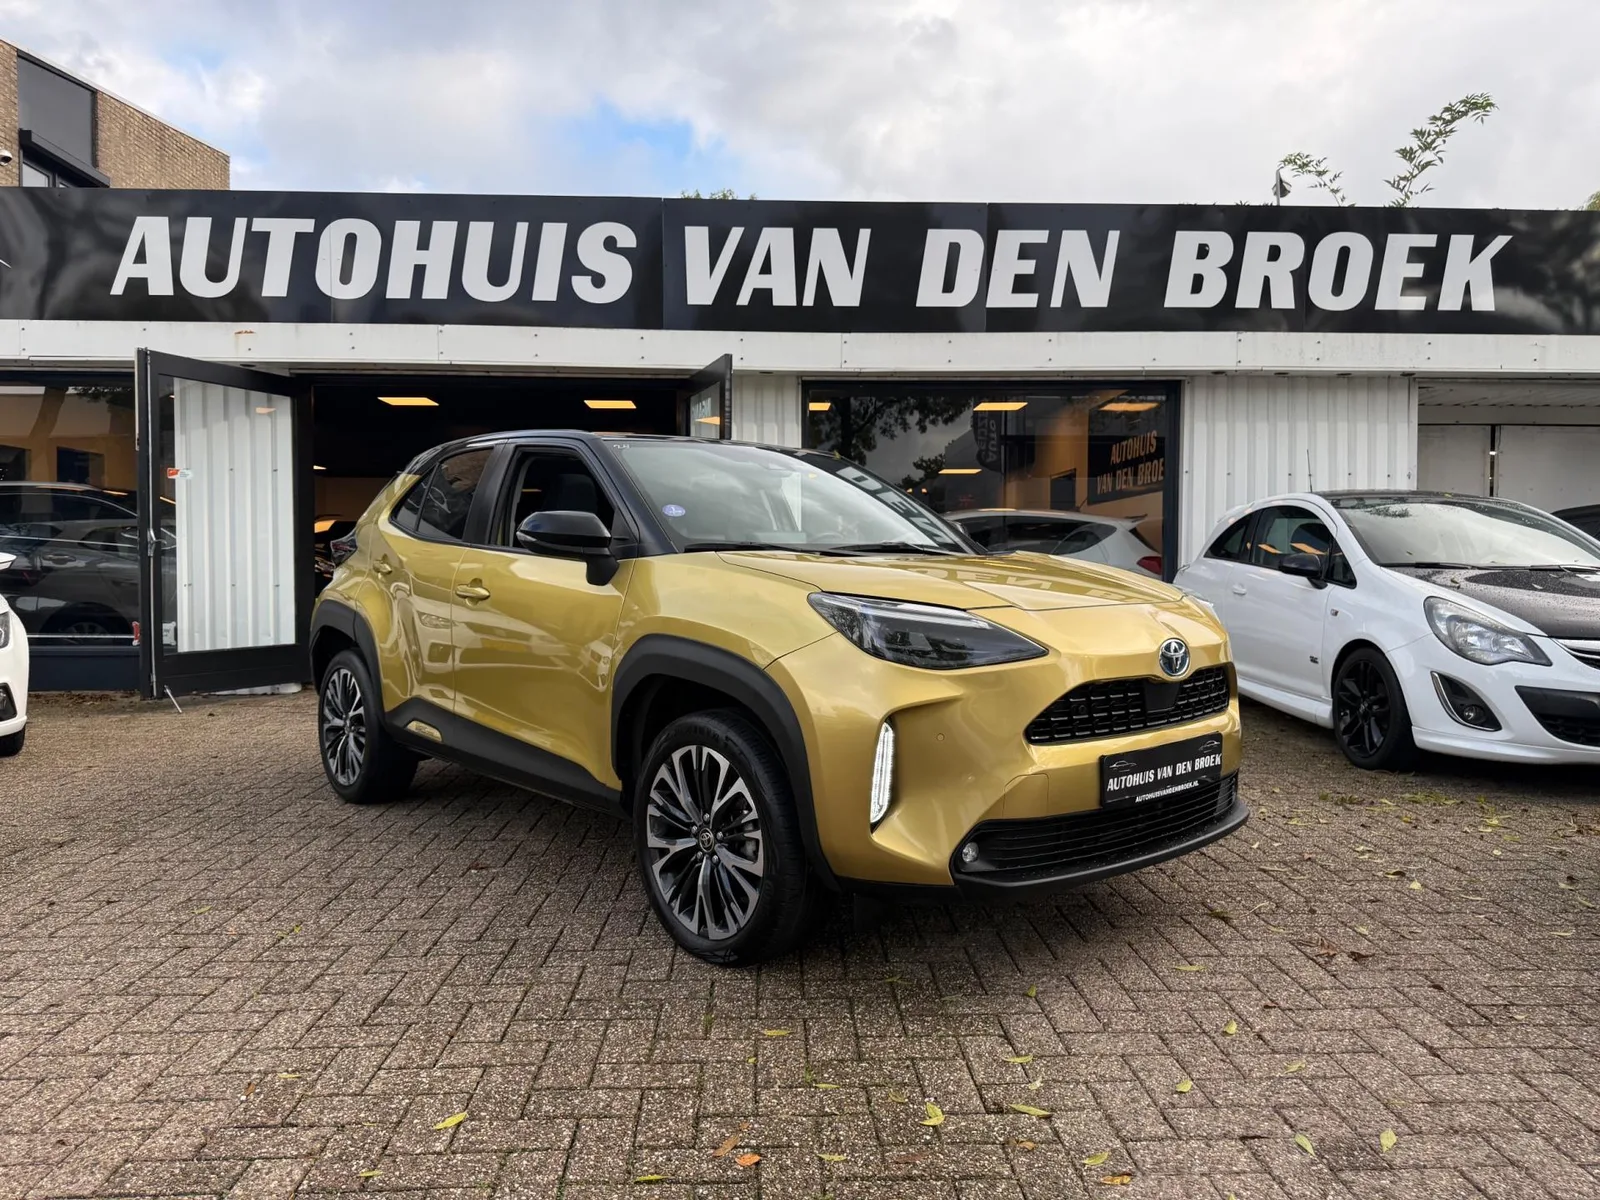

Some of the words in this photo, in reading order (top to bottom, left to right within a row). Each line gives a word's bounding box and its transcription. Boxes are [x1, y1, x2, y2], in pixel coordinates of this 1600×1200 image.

[109, 216, 637, 304] AUTOHUIS
[684, 225, 872, 307] VAN
[915, 228, 1121, 308] DEN
[1163, 230, 1513, 312] BROEK
[1110, 430, 1158, 466] AUTOHUIS
[1097, 472, 1113, 495] VAN
[1115, 466, 1135, 490] DEN
[1137, 458, 1164, 486] BROE
[1106, 769, 1155, 792] AUTOHUIS
[1157, 764, 1173, 780] VAN
[1175, 759, 1193, 776] DEN
[1194, 753, 1223, 771] BROEK
[1135, 780, 1200, 803] AUTOHUISVANDENBROEK.NL
